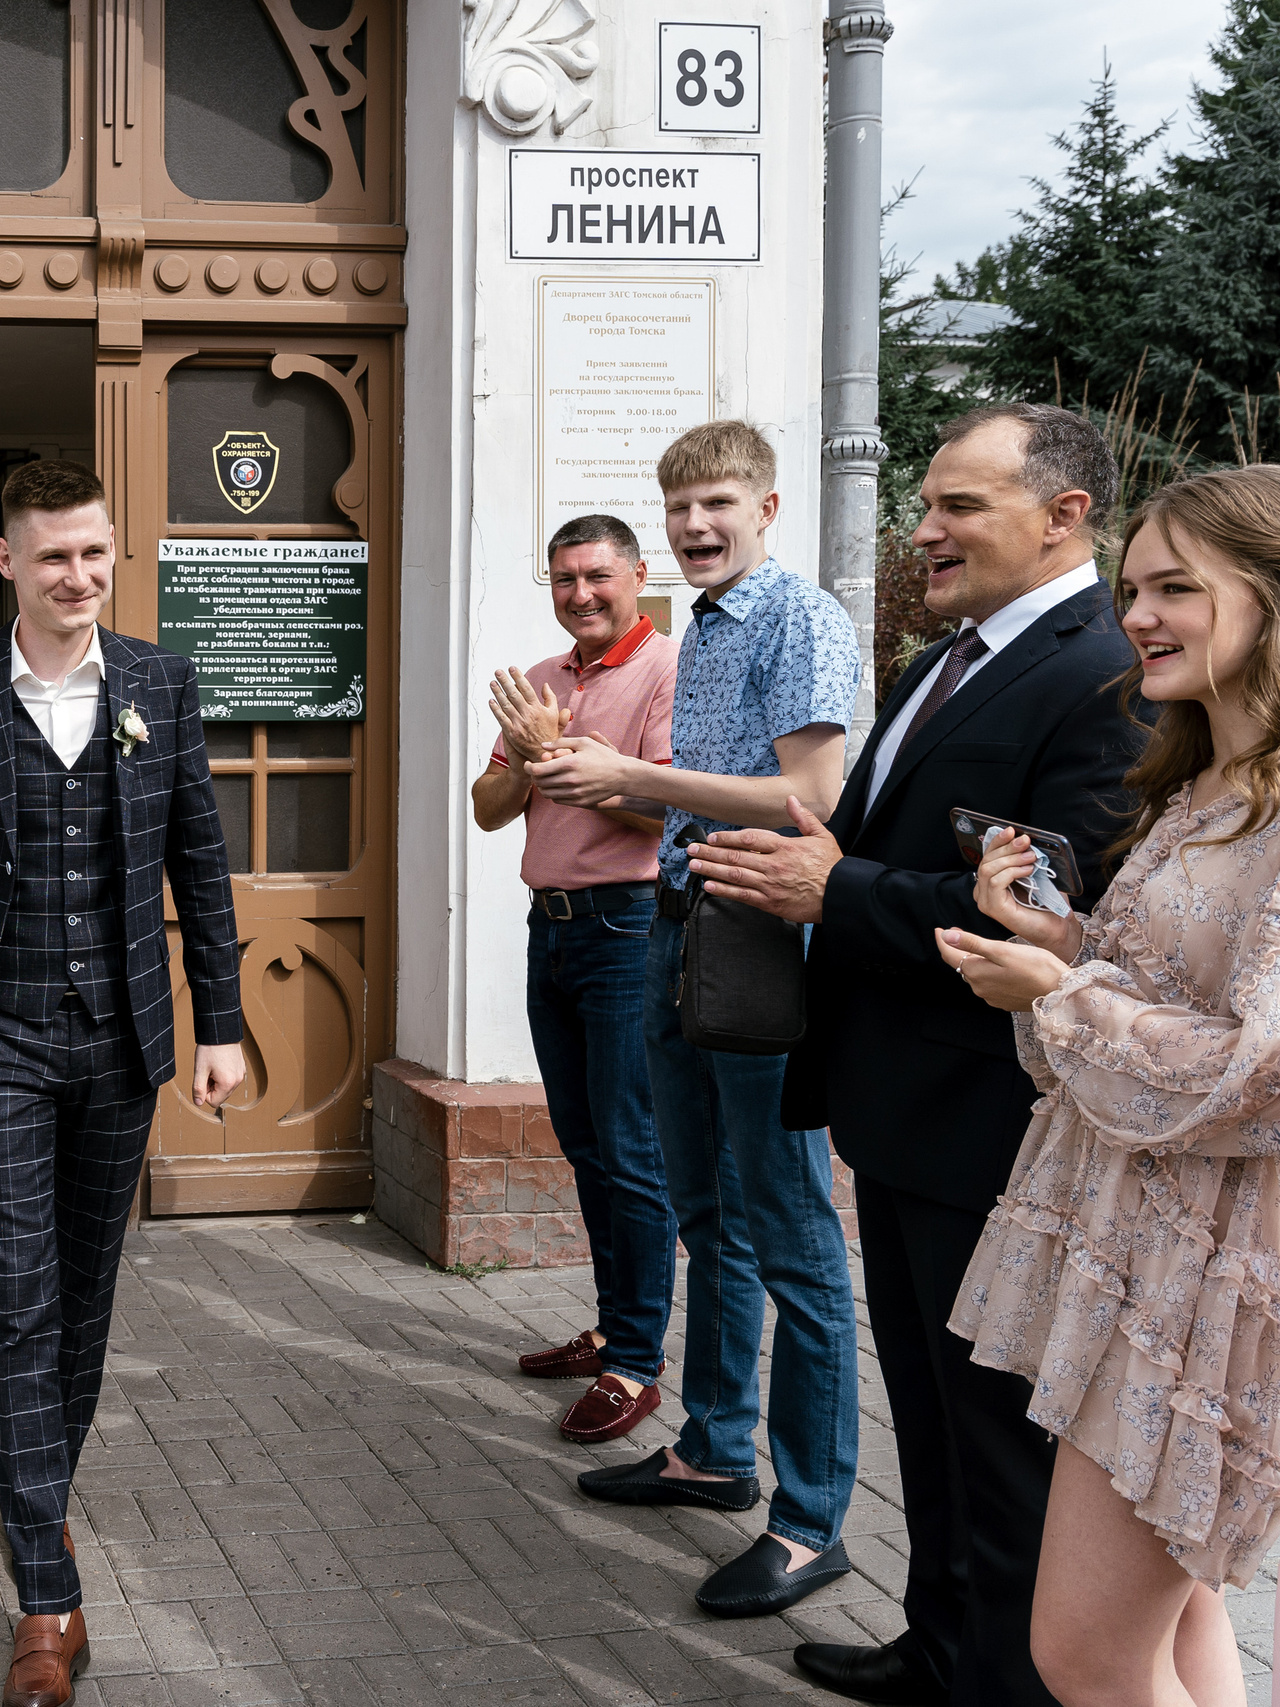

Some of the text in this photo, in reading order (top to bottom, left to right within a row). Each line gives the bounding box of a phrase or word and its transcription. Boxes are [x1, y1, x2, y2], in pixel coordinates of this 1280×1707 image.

[676, 49, 744, 107] 83
[570, 167, 699, 194] проспект
[547, 204, 725, 244] ЛЕНИНА
[551, 290, 606, 299] Департамент
[632, 291, 667, 299] Томской
[670, 291, 703, 299] области
[562, 312, 691, 323] Дворец бракосочетаний
[589, 327, 666, 336] города Томска
[586, 360, 616, 368] Прием
[593, 375, 675, 383] государственную
[549, 388, 611, 396] регистрацию
[673, 388, 704, 396] брака.
[555, 458, 635, 466] Государственная
[641, 471, 658, 479] бра
[162, 544, 365, 560] Уважаемые граждане!
[177, 565, 350, 575] При регистрации заключения брака
[211, 576, 269, 584] соблюдения
[306, 587, 324, 595] при
[270, 597, 301, 605] отдела
[304, 596, 328, 604] ЗАГС
[213, 606, 313, 615] убедительно просим:
[219, 621, 284, 629] новобрачных
[211, 640, 260, 649] разбивать
[262, 640, 299, 648] бокалы
[270, 656, 337, 664] пиротехникой
[202, 665, 268, 674] прилегающей
[279, 666, 311, 674] органу
[314, 665, 338, 673] ЗАГС
[233, 675, 293, 683] территории.
[214, 689, 312, 698] Заранее благодарим
